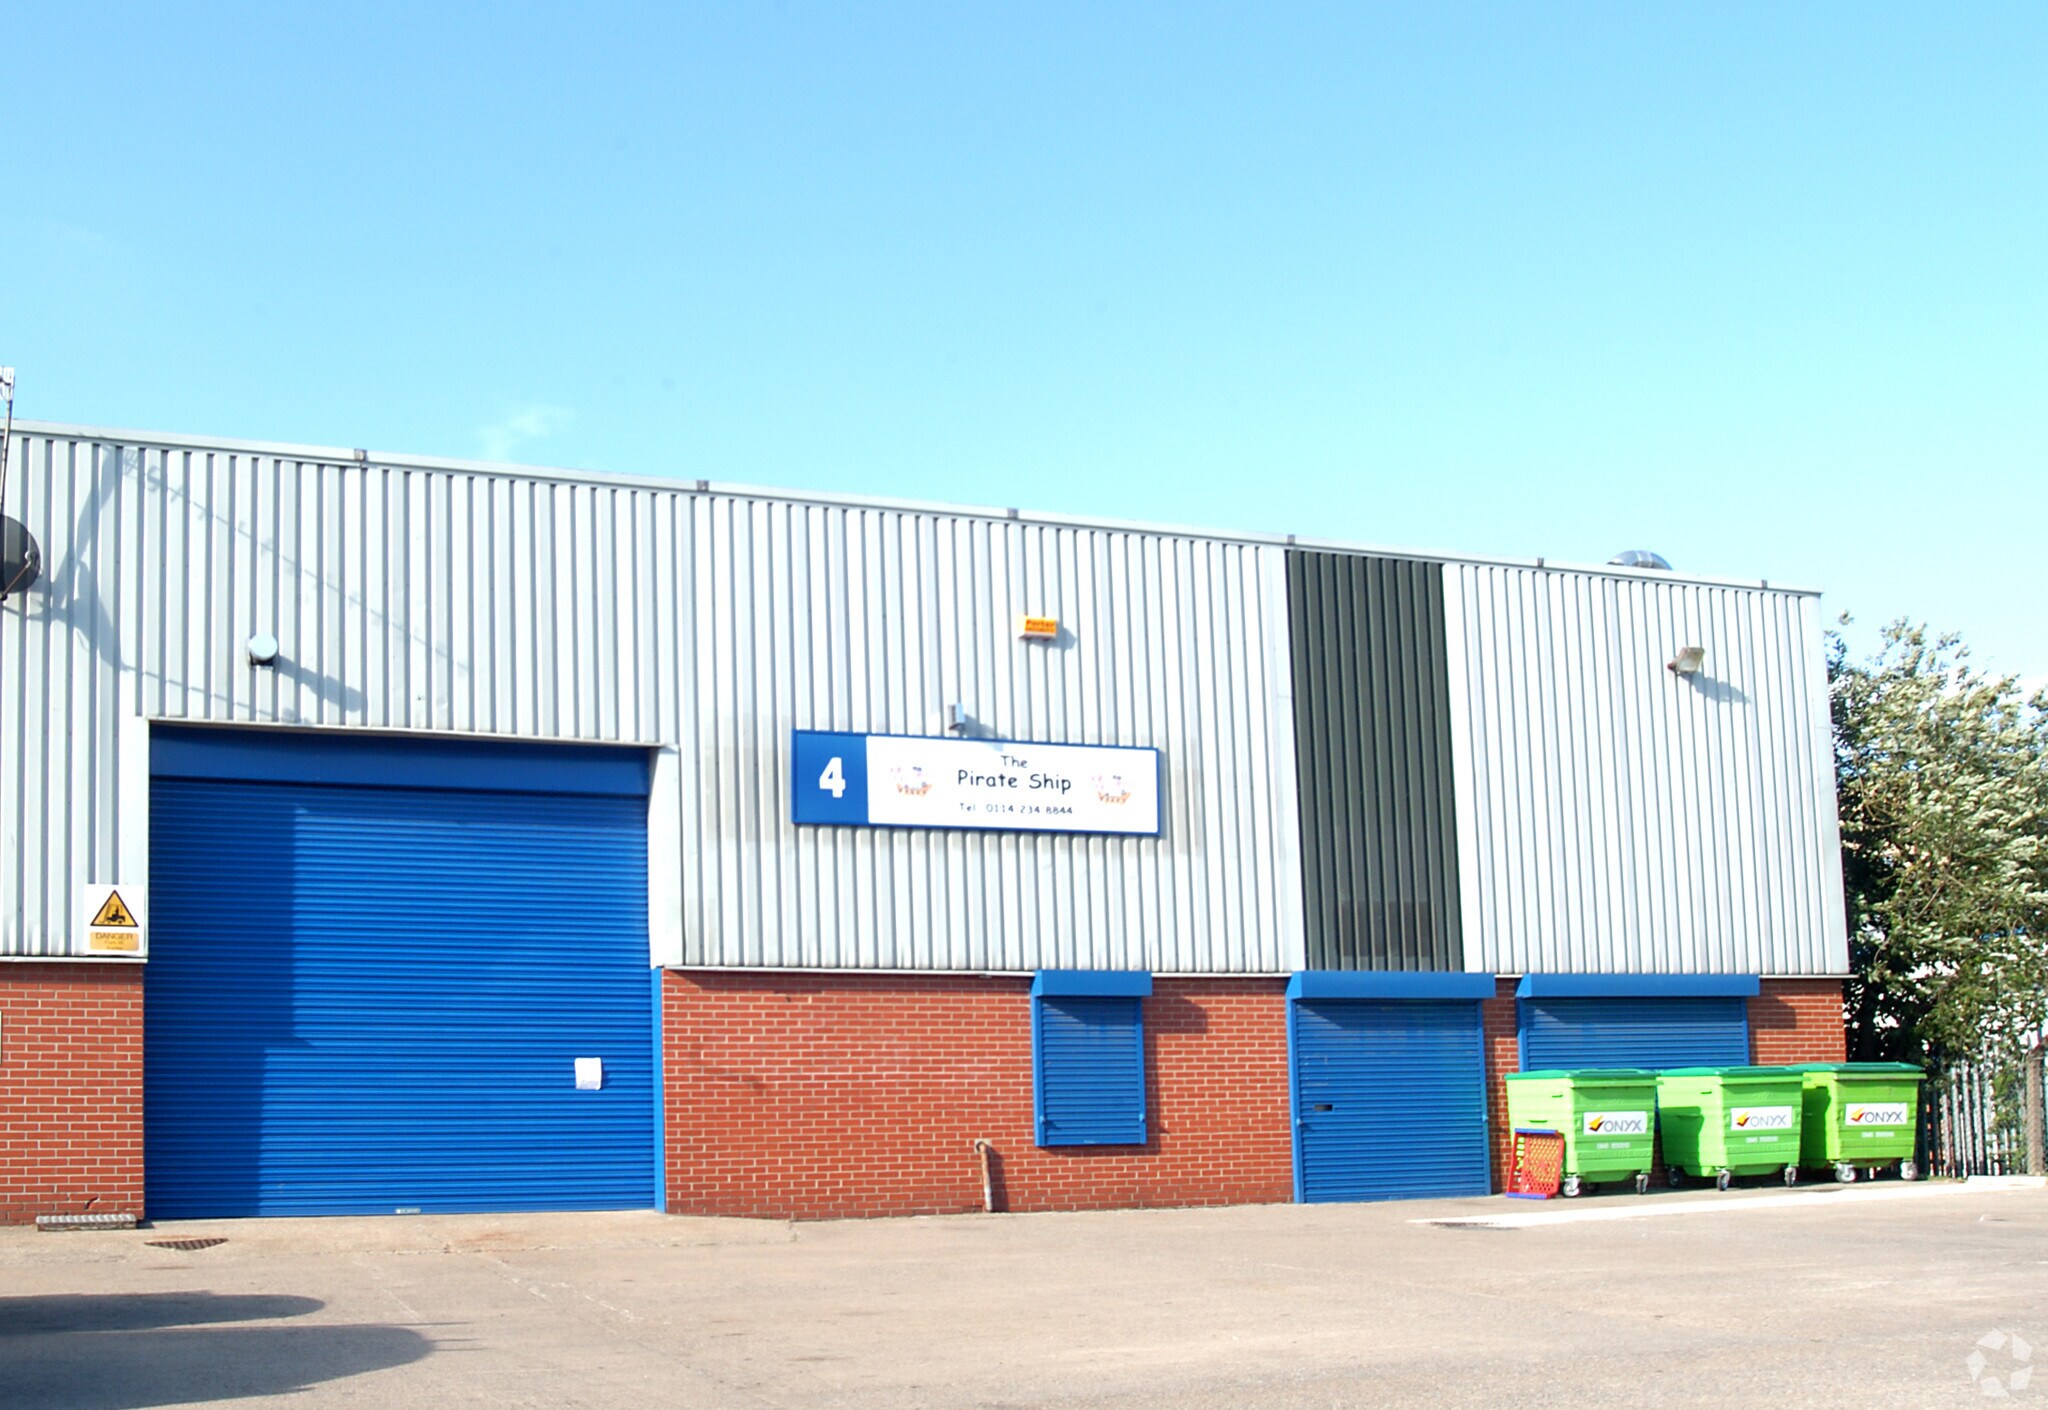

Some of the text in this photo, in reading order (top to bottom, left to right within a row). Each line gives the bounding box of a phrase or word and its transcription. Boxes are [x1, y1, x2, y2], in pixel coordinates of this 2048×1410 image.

[1000, 755, 1028, 768] The
[819, 757, 846, 798] 4
[958, 769, 1071, 795] Pirate Ship
[960, 803, 976, 811] Tel
[986, 803, 1014, 812] 0114
[1020, 805, 1040, 814] 234
[95, 932, 133, 940] DANGER
[1750, 1114, 1787, 1127] ONYX
[1865, 1111, 1903, 1123] ONYX
[1603, 1119, 1642, 1132] ONYX
